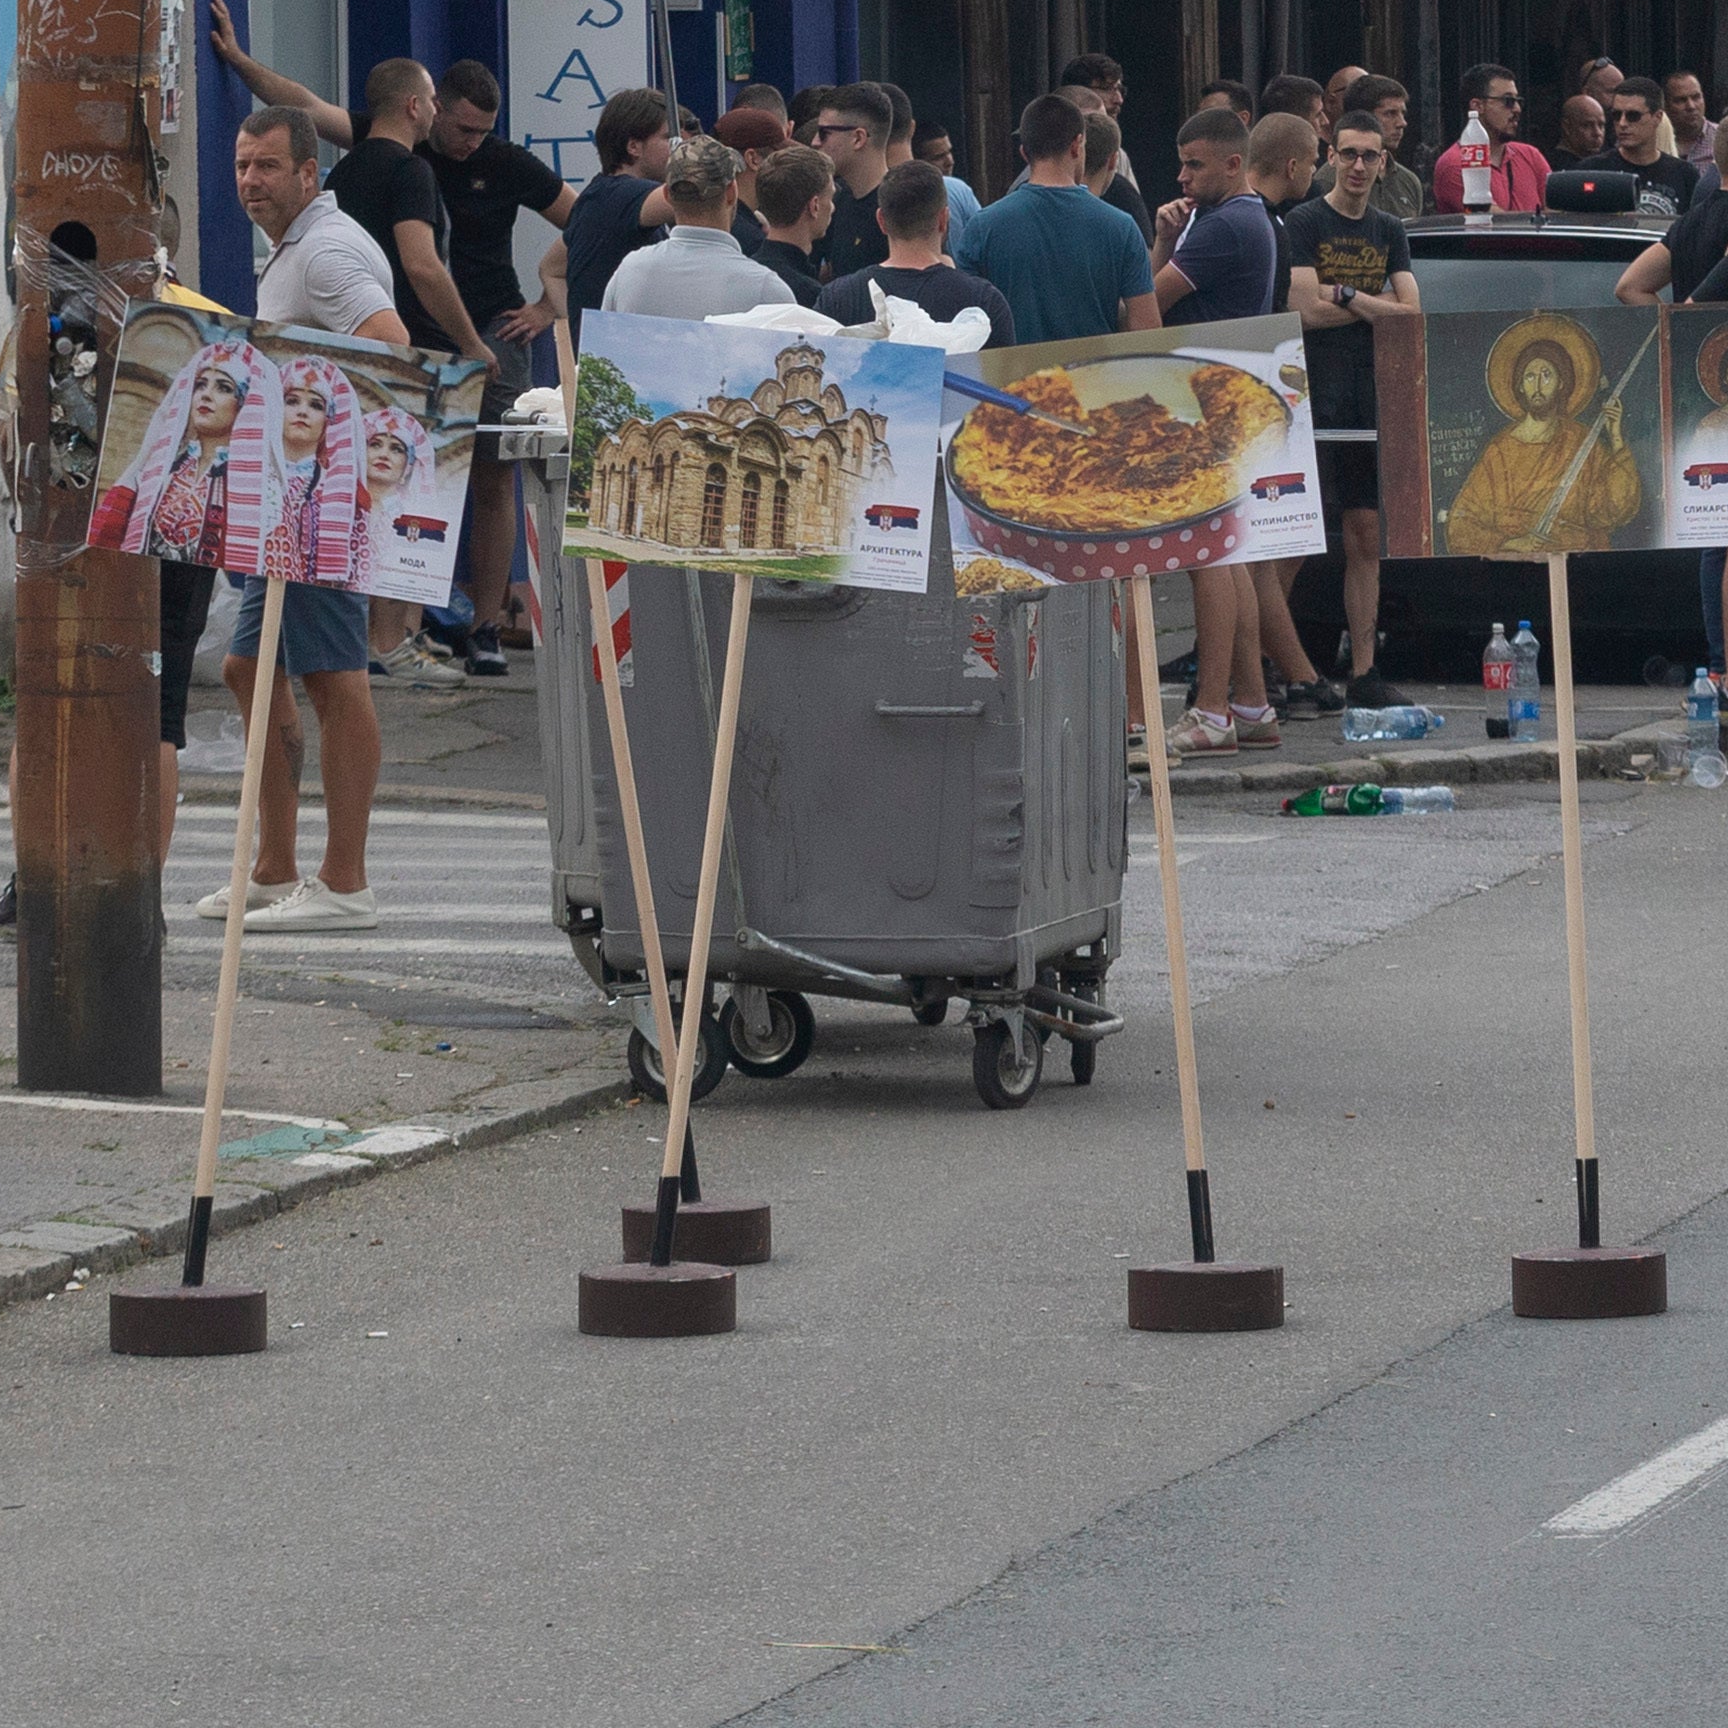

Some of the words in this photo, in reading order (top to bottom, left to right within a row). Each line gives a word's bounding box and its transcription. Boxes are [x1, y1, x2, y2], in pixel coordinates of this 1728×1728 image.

[1250, 512, 1319, 527] КУЛИНАРСТВО
[860, 544, 924, 558] АРХИТЕКТУРА
[399, 557, 426, 569] МОДА
